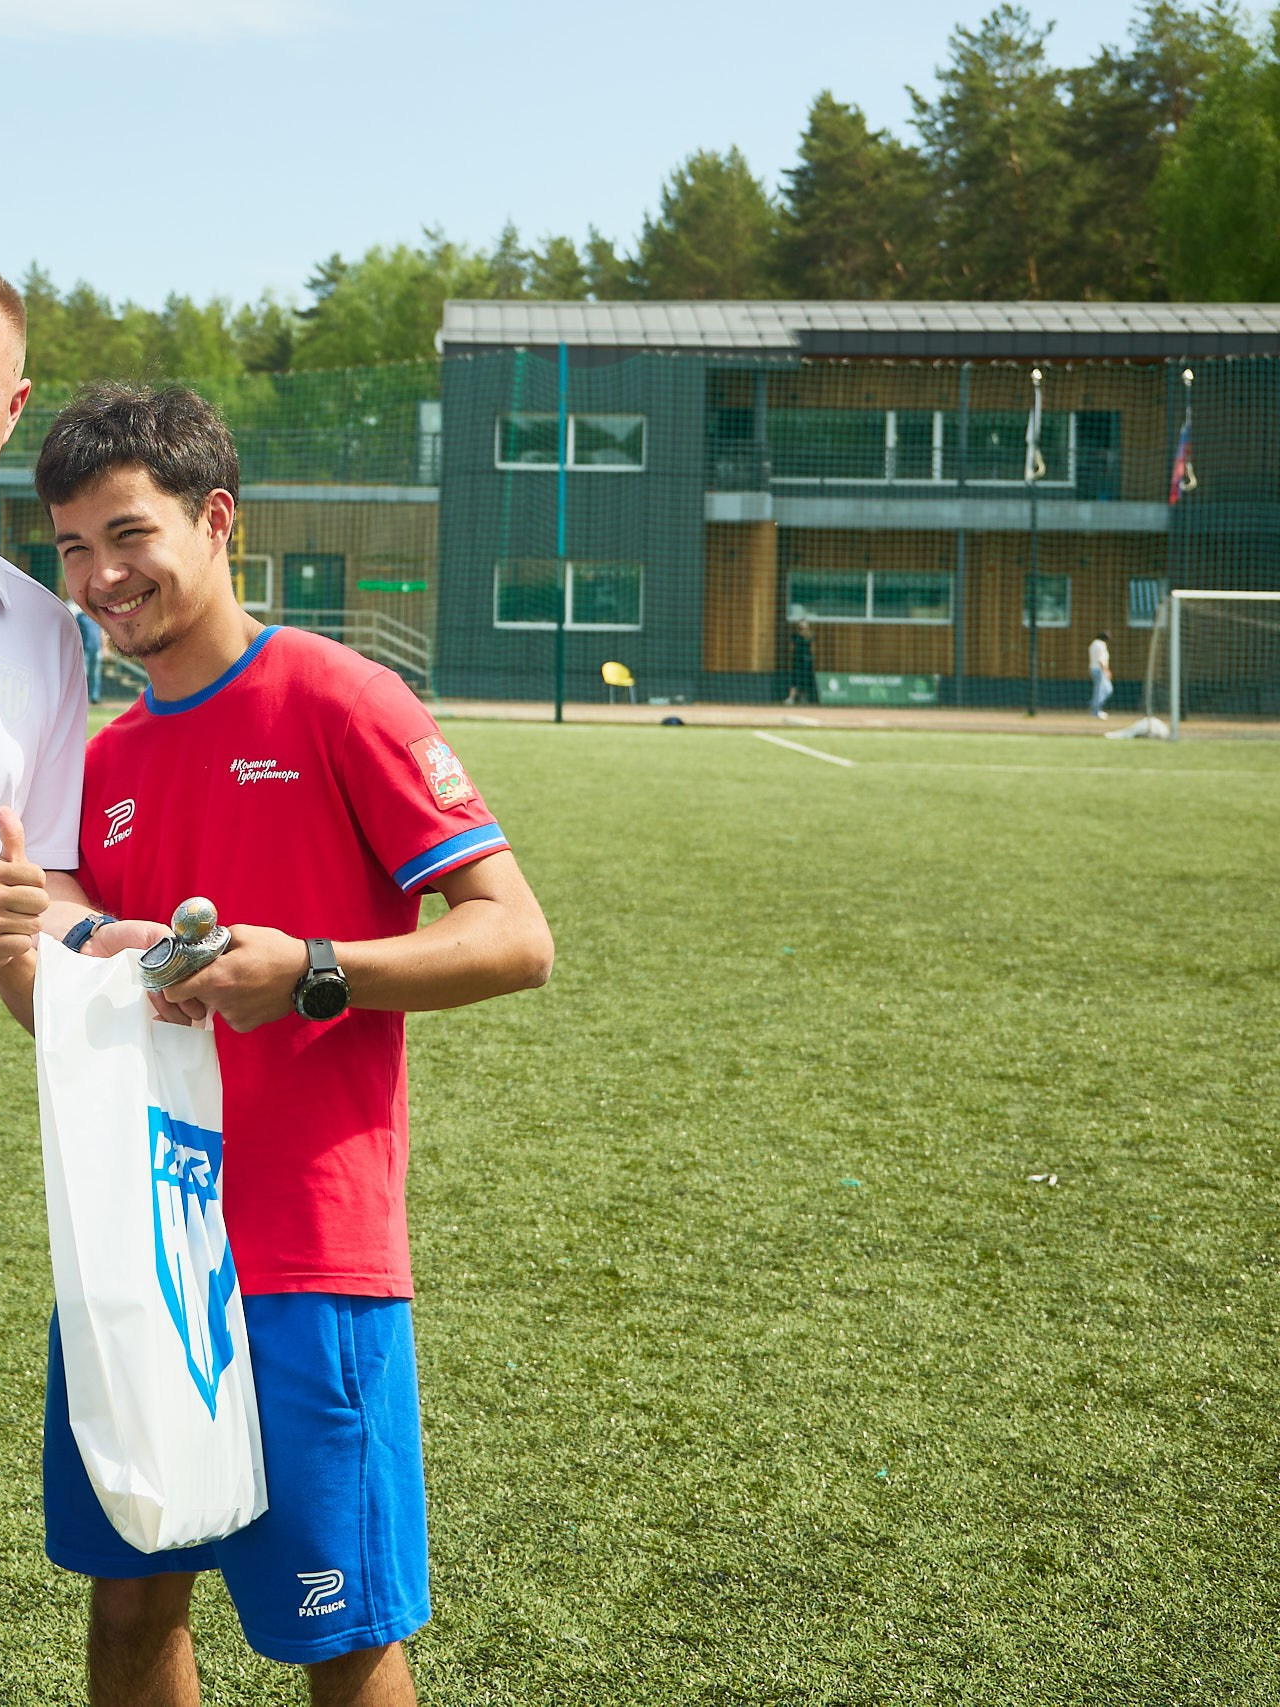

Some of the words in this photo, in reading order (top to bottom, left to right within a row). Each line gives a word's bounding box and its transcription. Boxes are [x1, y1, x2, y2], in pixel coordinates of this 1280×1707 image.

[230, 759, 277, 772] #Команда
[237, 768, 300, 785] Губернатора
[299, 1599, 346, 1617] PATRICK
